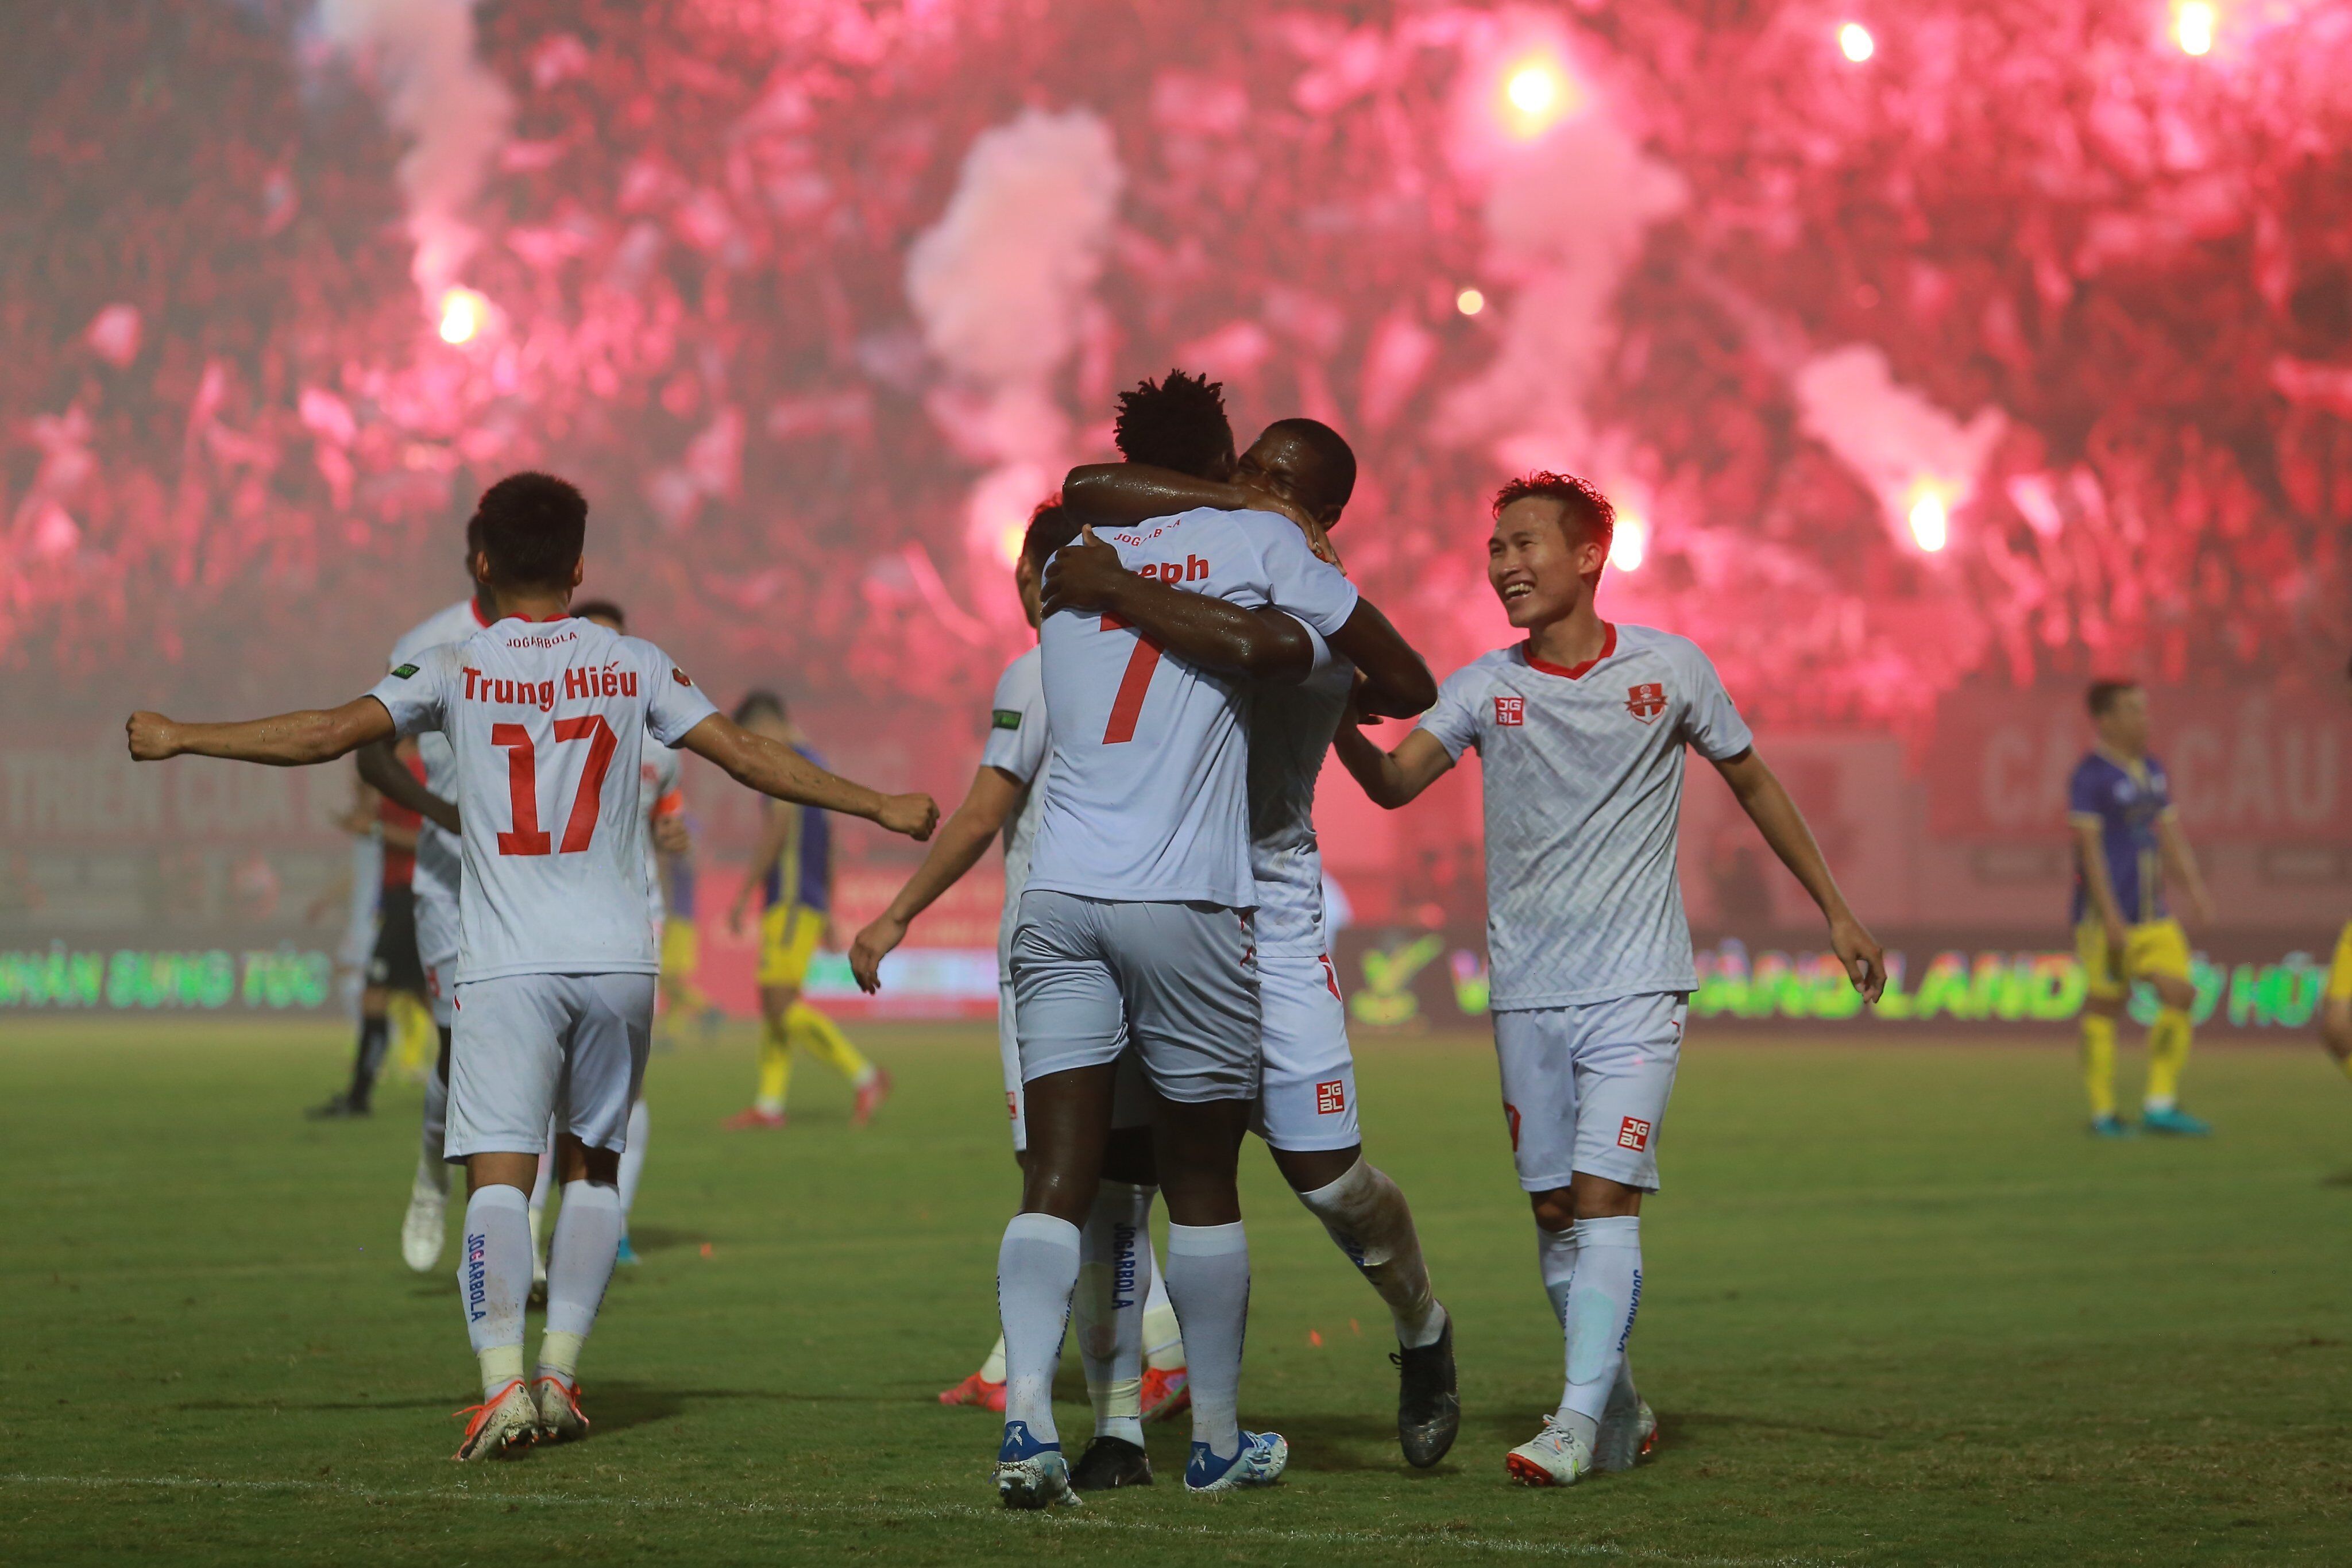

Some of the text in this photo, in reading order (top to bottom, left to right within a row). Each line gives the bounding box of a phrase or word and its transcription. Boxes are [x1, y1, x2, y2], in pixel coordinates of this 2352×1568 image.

[507, 631, 578, 648] JOGARBOLA
[1099, 612, 1165, 745] 7
[462, 661, 637, 712] Trung Hiếu
[491, 714, 618, 856] 17
[468, 1233, 486, 1322] JOGARBOLA
[1110, 1222, 1137, 1311] JOGARBOLA
